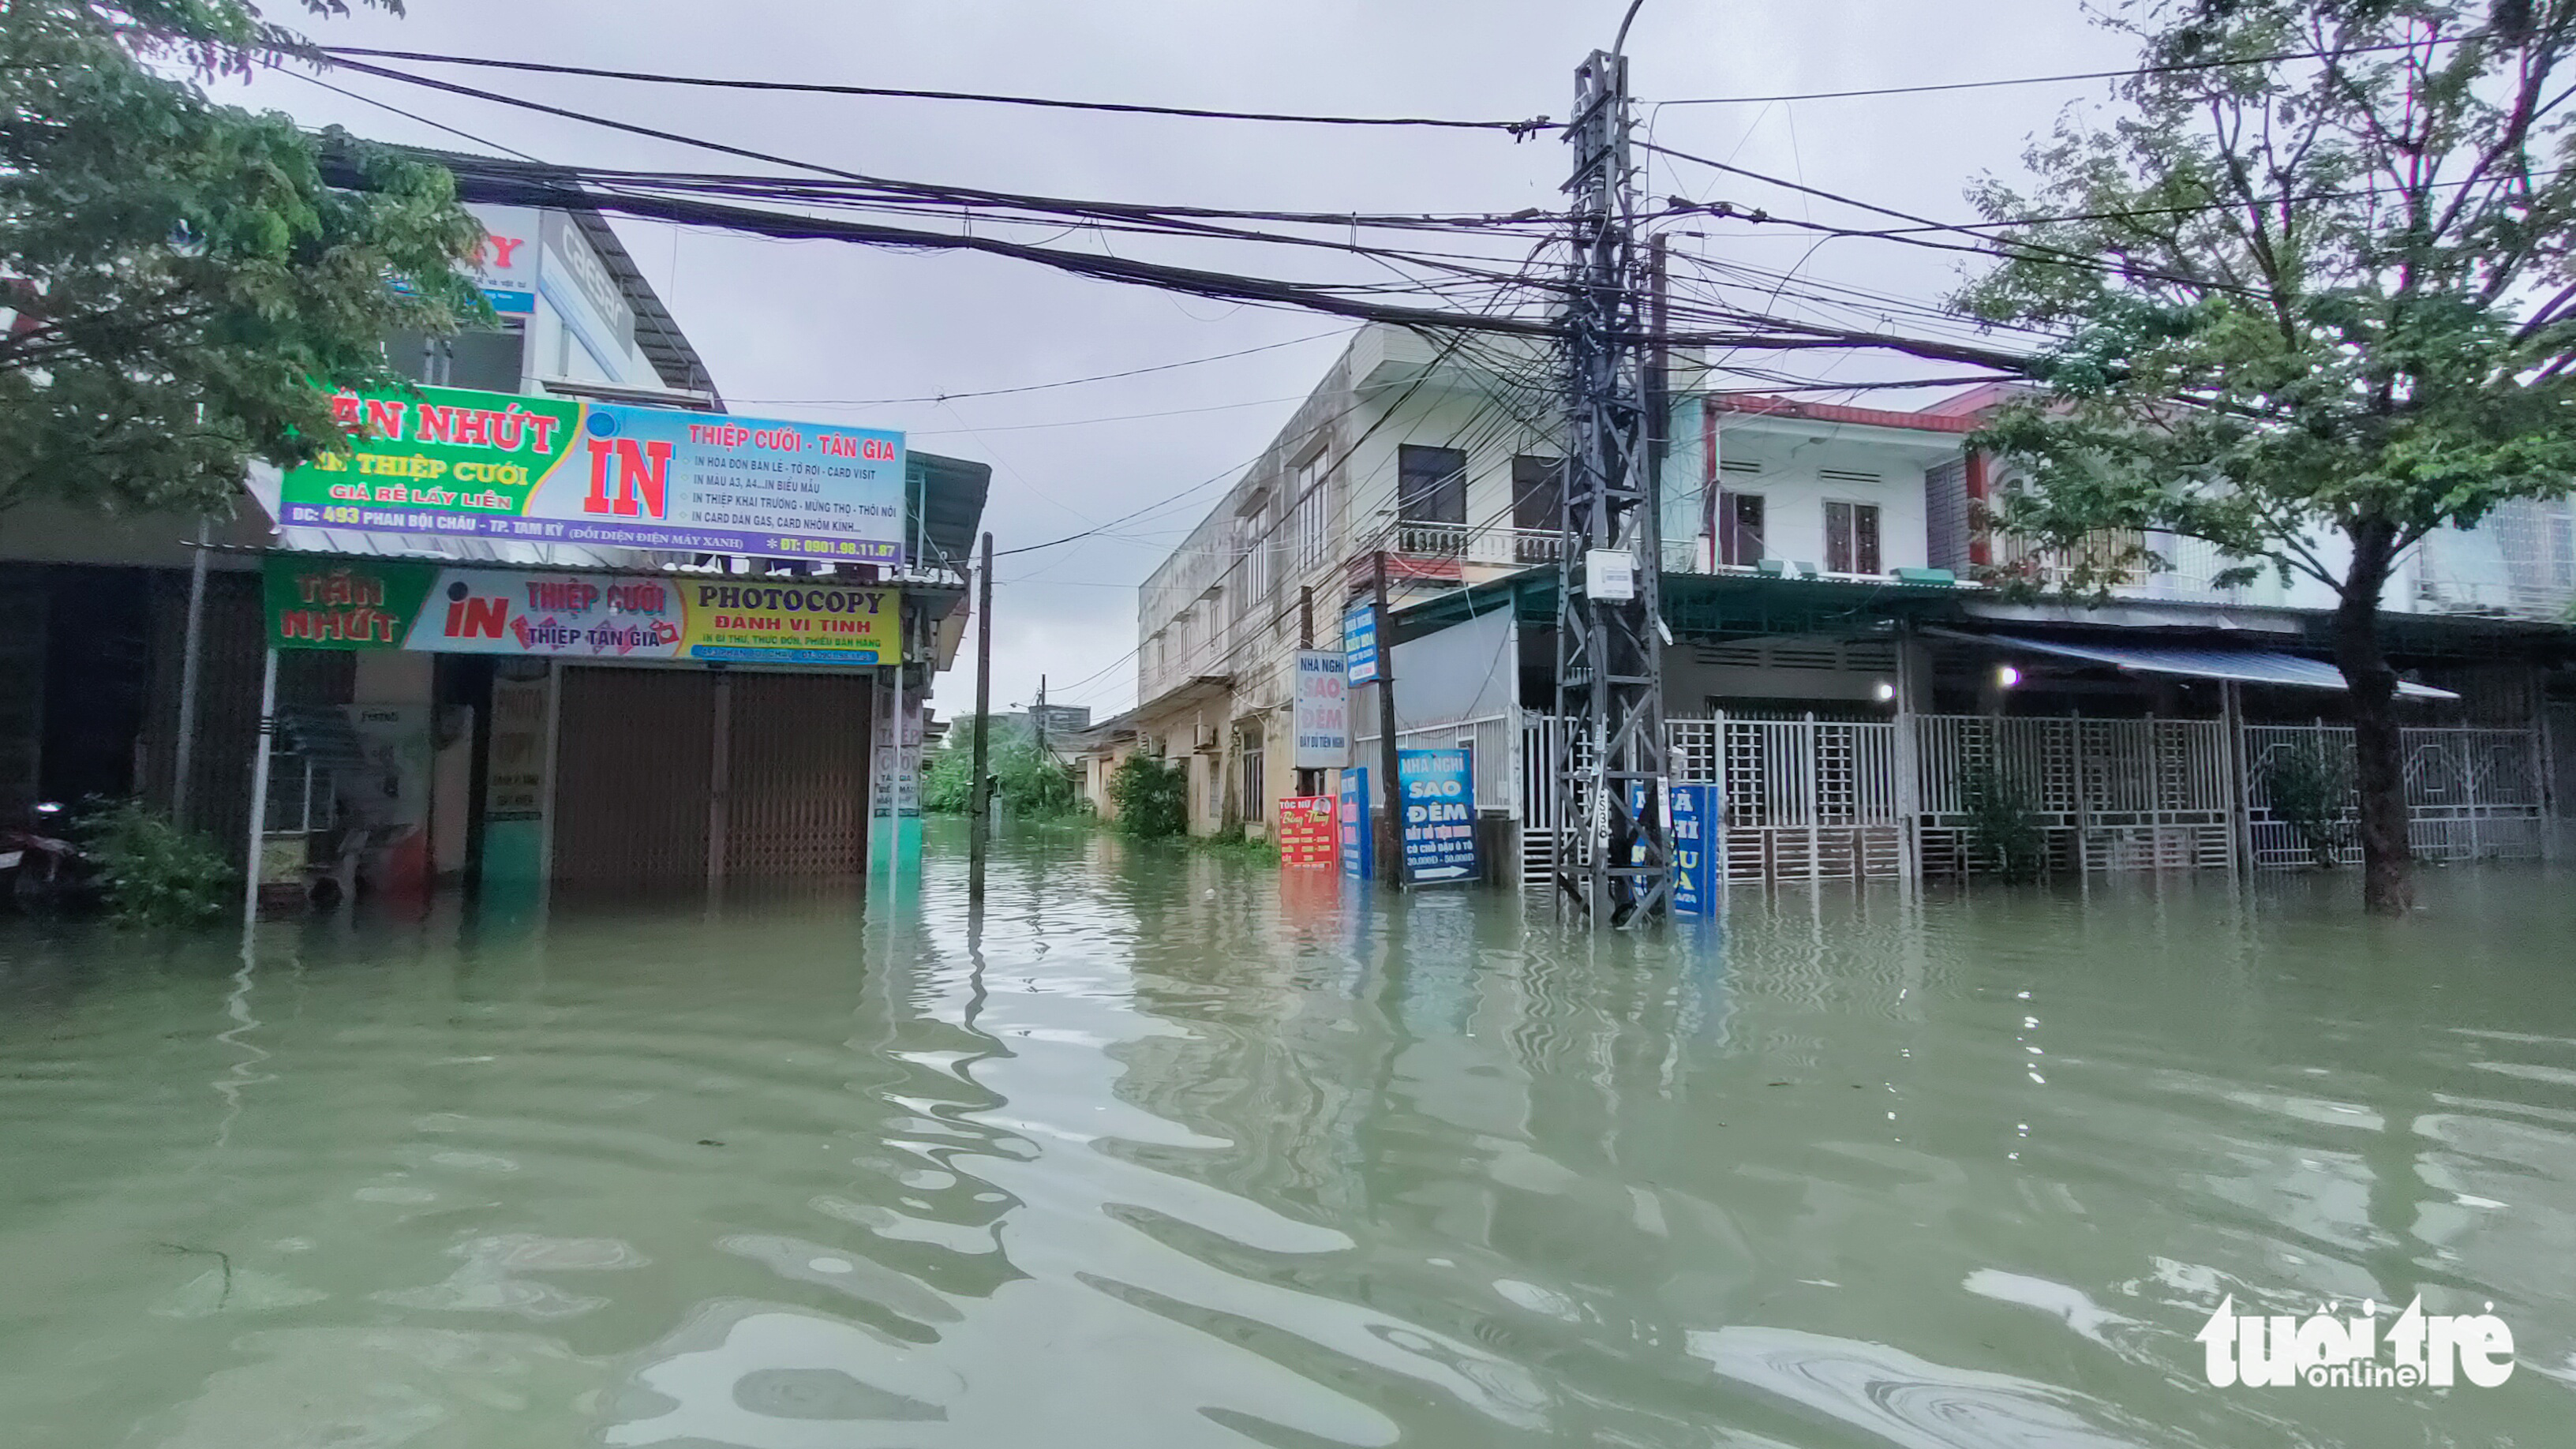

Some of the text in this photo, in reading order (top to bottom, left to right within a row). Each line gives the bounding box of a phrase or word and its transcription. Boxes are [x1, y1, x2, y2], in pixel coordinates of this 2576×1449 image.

[562, 224, 623, 328] Caesar
[417, 402, 560, 455] NHỨT
[689, 422, 750, 453] THIỆP
[754, 427, 801, 453] CƯỚI
[818, 432, 857, 459] TÂN
[863, 440, 896, 461] GIA
[356, 453, 447, 483] THIỆP
[453, 459, 530, 486] CƯỚI
[582, 411, 676, 520] IN
[695, 455, 705, 466] IN
[827, 466, 852, 478] CARD
[853, 468, 876, 480] VISIT
[694, 474, 704, 485] IN
[729, 477, 743, 490] A3,
[411, 485, 458, 505] LẤY
[693, 492, 702, 504] IN
[706, 492, 733, 508] THIỆP
[736, 495, 758, 507] KHAI
[833, 503, 852, 517] THỌ
[859, 504, 879, 516] THÔI
[882, 505, 897, 518] NÔI
[323, 506, 360, 524] 493
[363, 511, 405, 526] PHAN
[408, 513, 433, 530] BỘI
[436, 515, 476, 531] CHÂU
[489, 519, 510, 533] TP.
[513, 521, 542, 536] TAM
[545, 522, 564, 537] KỲ
[691, 511, 702, 522] IN
[705, 512, 729, 524] CARD
[754, 515, 774, 529] GAS,
[777, 517, 801, 529] CARD
[803, 518, 829, 531] NHÔM
[601, 530, 634, 544] DIỆN
[636, 532, 669, 545] ĐIỆN
[671, 533, 701, 546] MÁY
[702, 537, 743, 550] XANH)
[781, 537, 895, 557] ĐT: 0901.98.11.87
[526, 577, 667, 620] THIỆP CƯỚI
[698, 585, 886, 614] PHOTOCOPY
[790, 619, 811, 631] VI
[819, 617, 871, 633] TÍNH
[586, 627, 623, 646] TÂN
[630, 631, 660, 647] GIA
[1301, 655, 1320, 672] NHÀ
[1304, 677, 1341, 698] SAO
[1301, 705, 1342, 729] ĐÊM
[1401, 752, 1465, 774] NHÀ NGHỈ
[1408, 780, 1462, 799] SAO
[1406, 802, 1468, 823] ĐÊM
